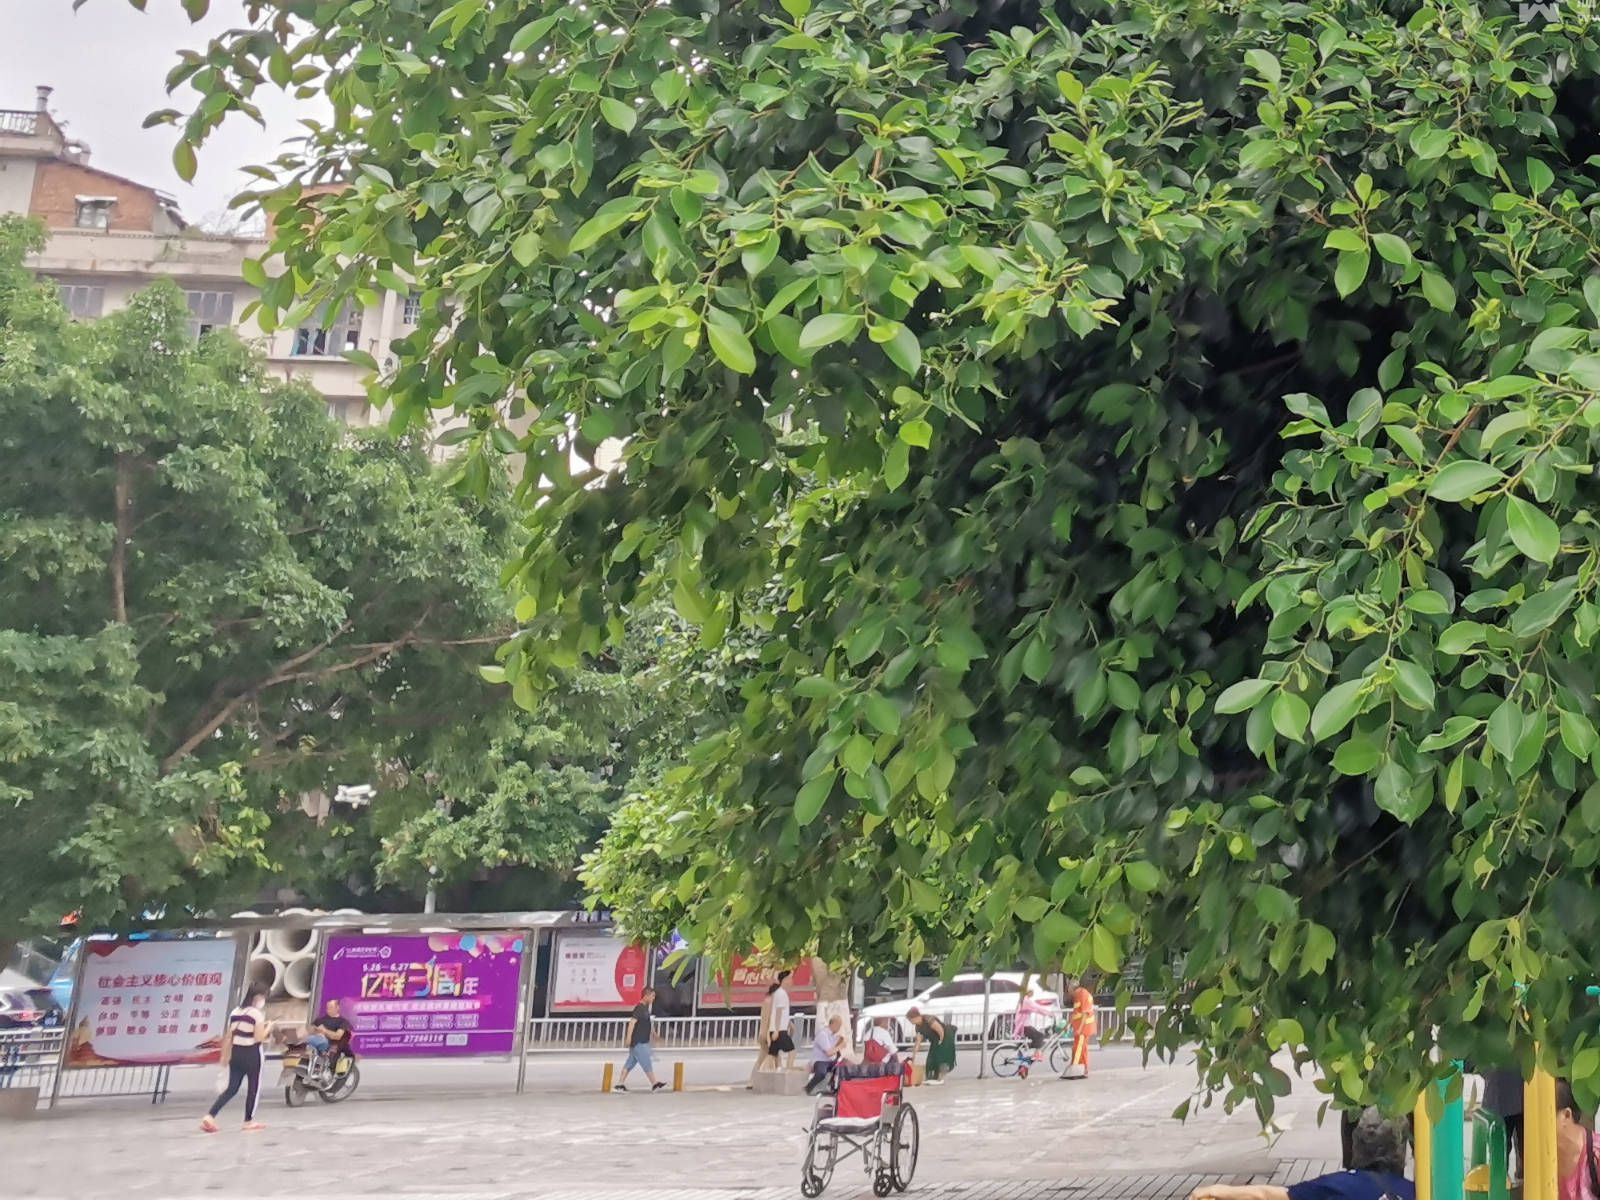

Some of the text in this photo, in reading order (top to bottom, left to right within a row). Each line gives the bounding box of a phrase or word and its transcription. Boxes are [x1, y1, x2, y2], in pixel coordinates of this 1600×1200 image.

[98, 972, 222, 988] 社会主义核心价值观
